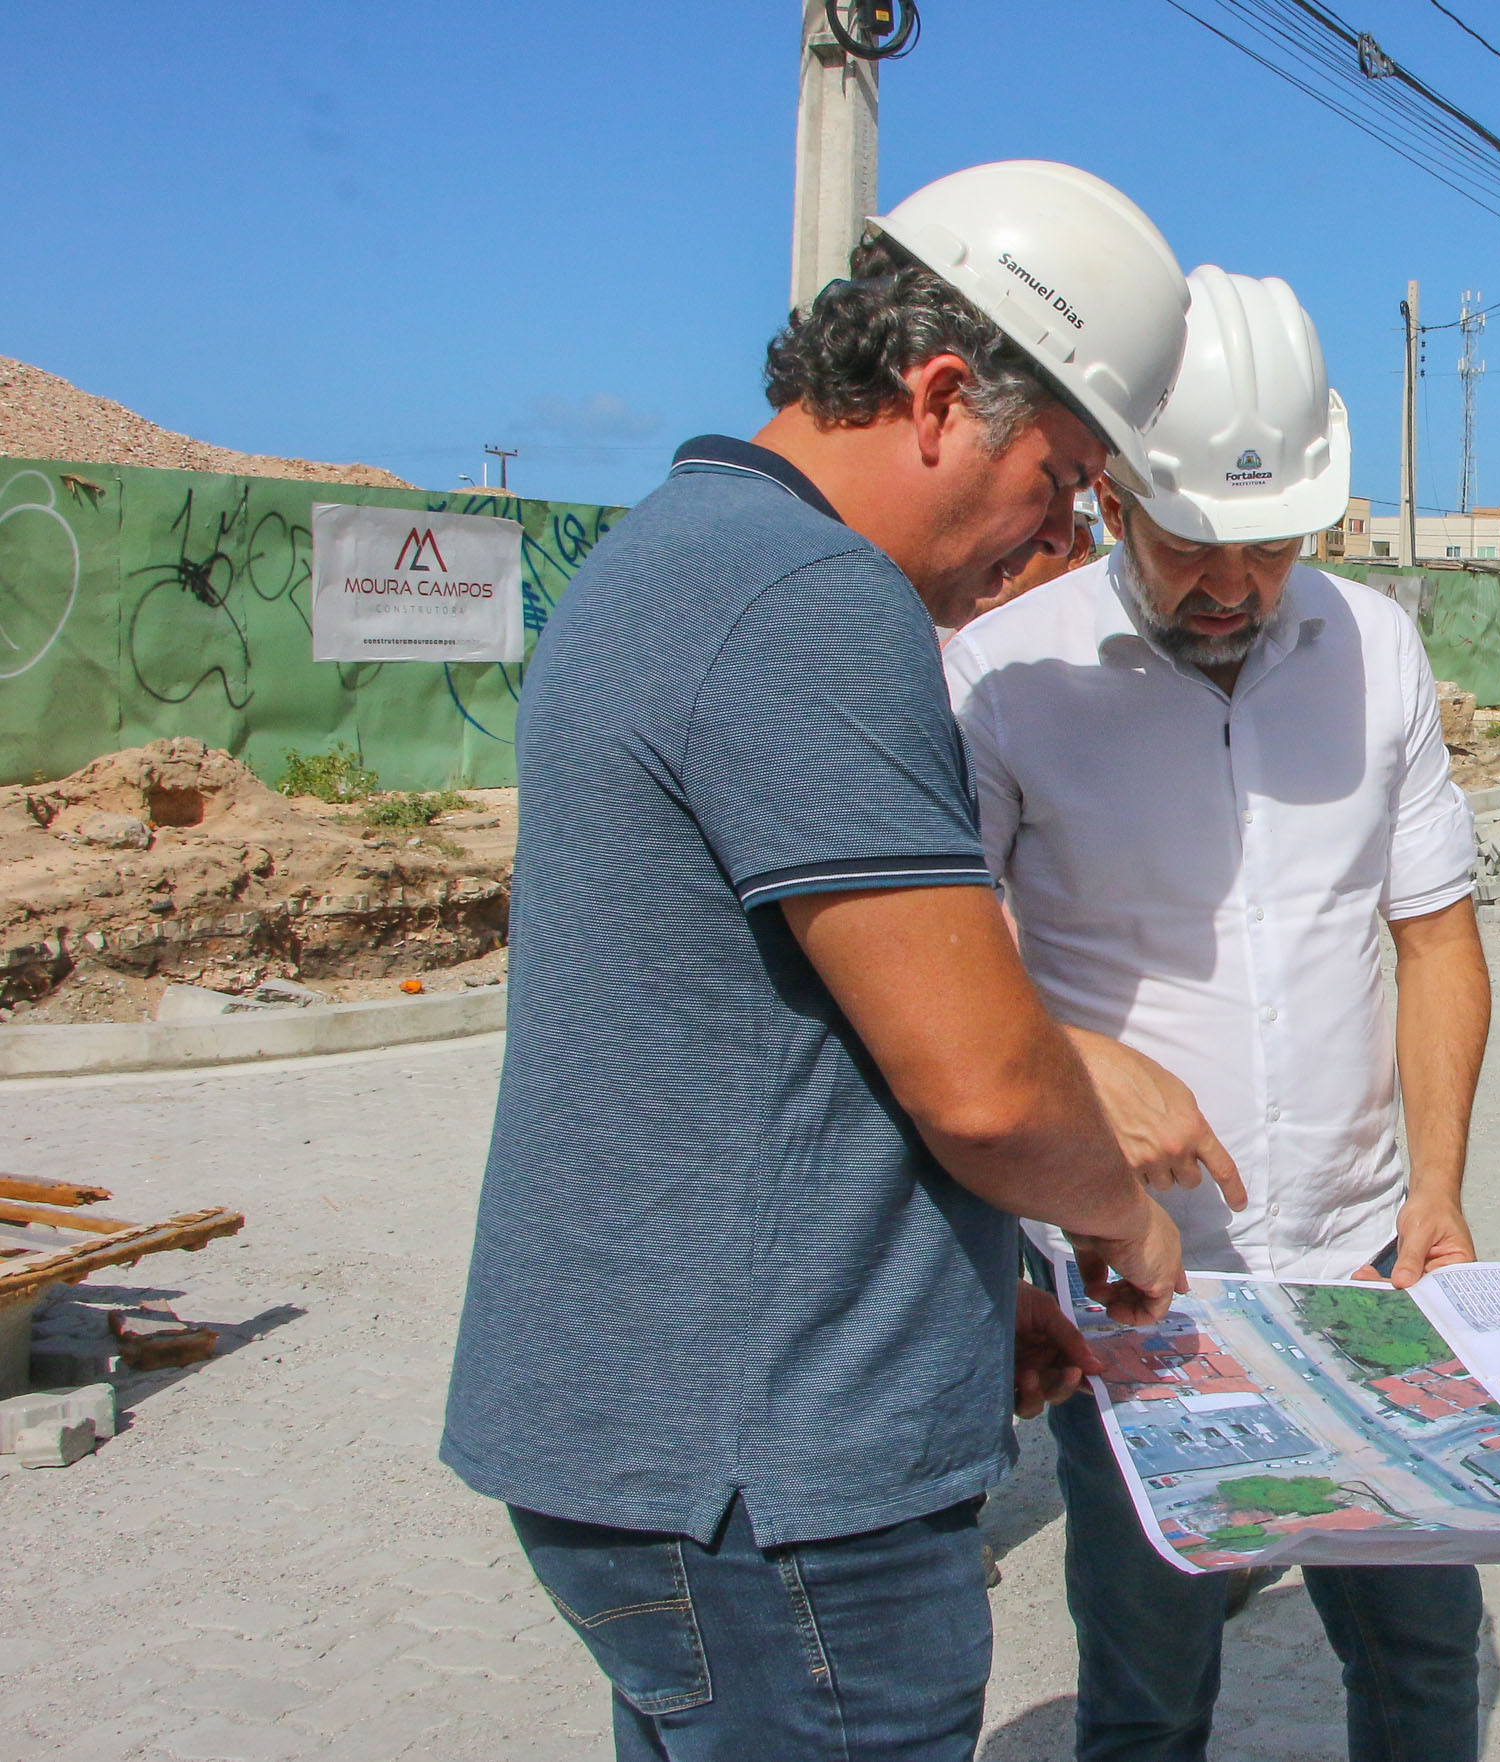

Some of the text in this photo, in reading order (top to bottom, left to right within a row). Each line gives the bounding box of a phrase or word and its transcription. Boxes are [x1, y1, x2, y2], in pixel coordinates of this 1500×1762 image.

[998, 253, 1085, 329] Samuel Dias
[1226, 471, 1272, 481] Fortaleza
[344, 577, 493, 598] MOURA CAMPOS
[375, 603, 465, 615] CONSTRUTORA
